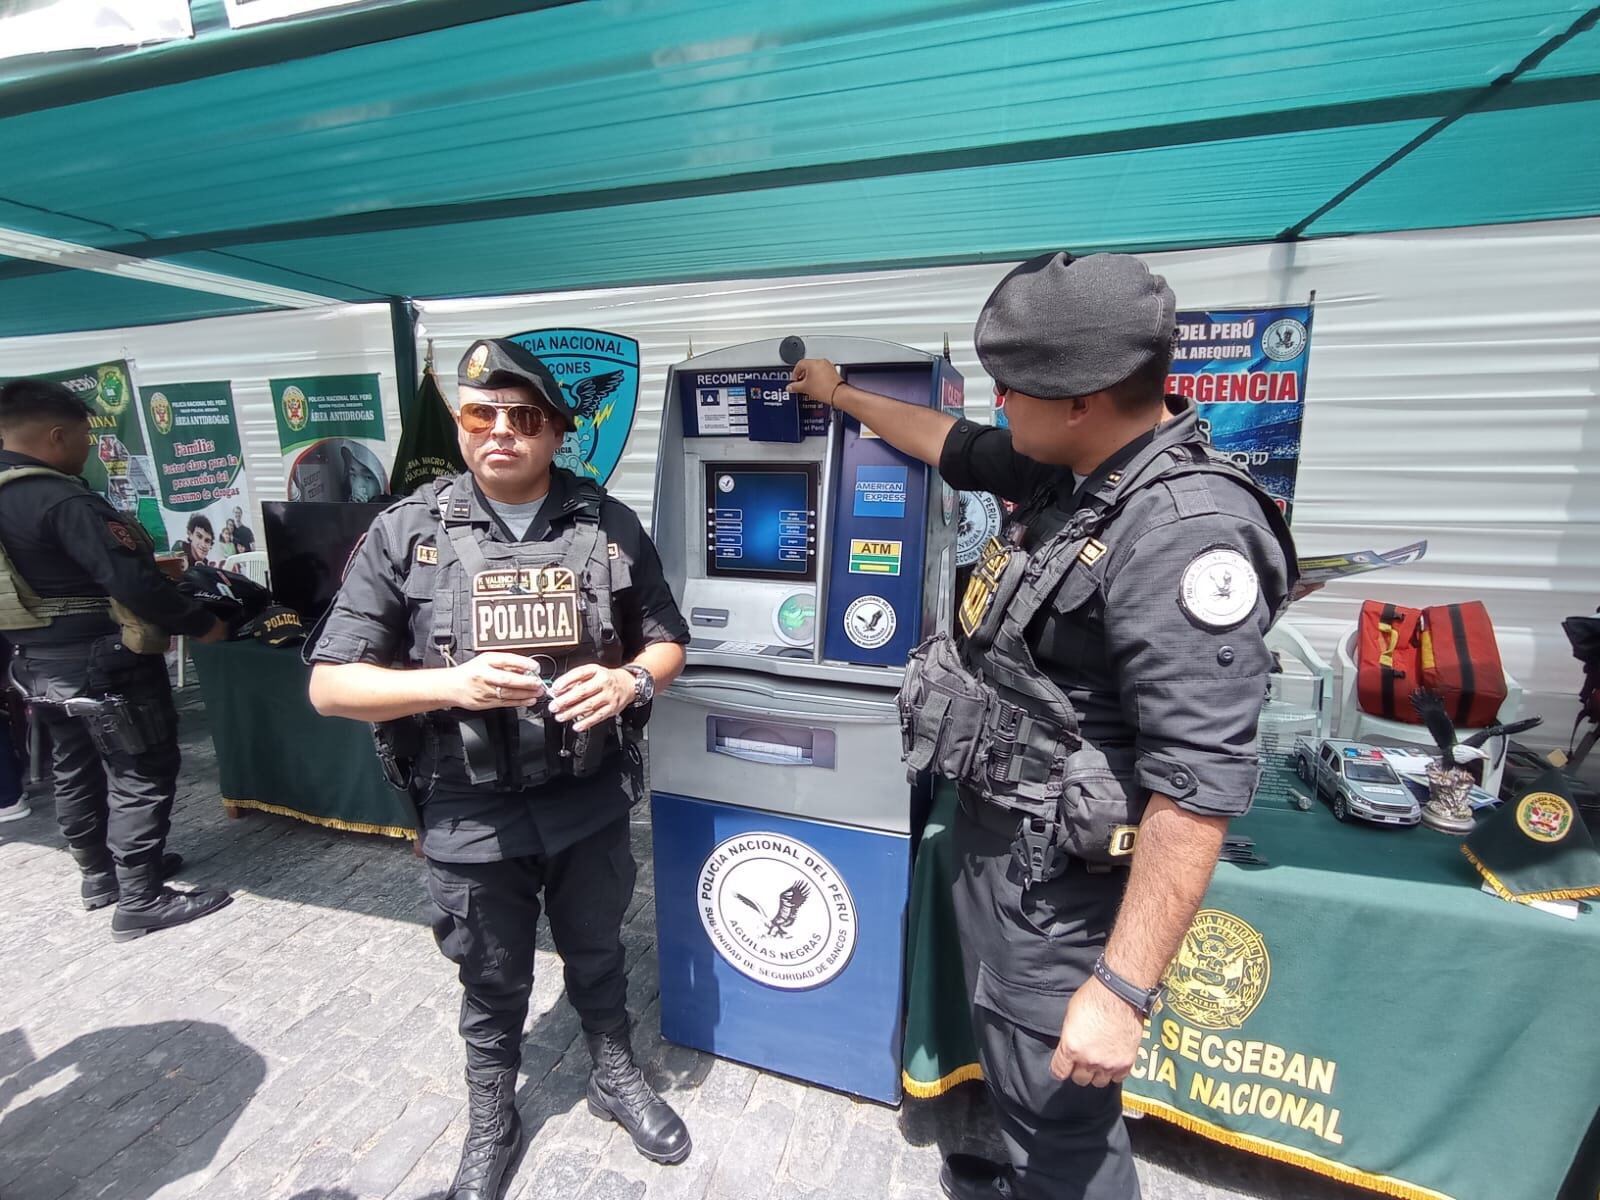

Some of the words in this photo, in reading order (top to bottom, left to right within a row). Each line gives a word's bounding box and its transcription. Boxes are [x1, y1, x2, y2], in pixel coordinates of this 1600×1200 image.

[1179, 324, 1207, 340] DEL
[1209, 319, 1254, 339] PERÚ
[550, 336, 624, 356] NACIONAL
[547, 361, 591, 375] CONES
[763, 388, 790, 402] caja
[1163, 371, 1299, 404] ERGENCIA
[311, 409, 328, 421] ÁREA
[330, 410, 374, 421] ANTIDROGAS
[856, 482, 904, 492] AMERICAN
[864, 492, 906, 503] EXPRESS
[861, 543, 891, 554] ATM
[478, 602, 573, 641] POLICIA
[728, 839, 799, 860] NACIONAL
[804, 856, 827, 882] DEL
[828, 883, 850, 923] PERU
[730, 919, 776, 958] AGUILAS
[780, 932, 822, 960] NEGRAS
[1217, 916, 1262, 957] NACIONAL
[743, 958, 756, 970] DE
[758, 966, 815, 981] SEGURIDAD
[815, 962, 828, 975] DE
[826, 928, 847, 965] BANCOS
[1161, 1018, 1336, 1095] SECSEBAN
[1129, 1043, 1177, 1090] CÍA
[1189, 1071, 1344, 1145] NACIONAL
